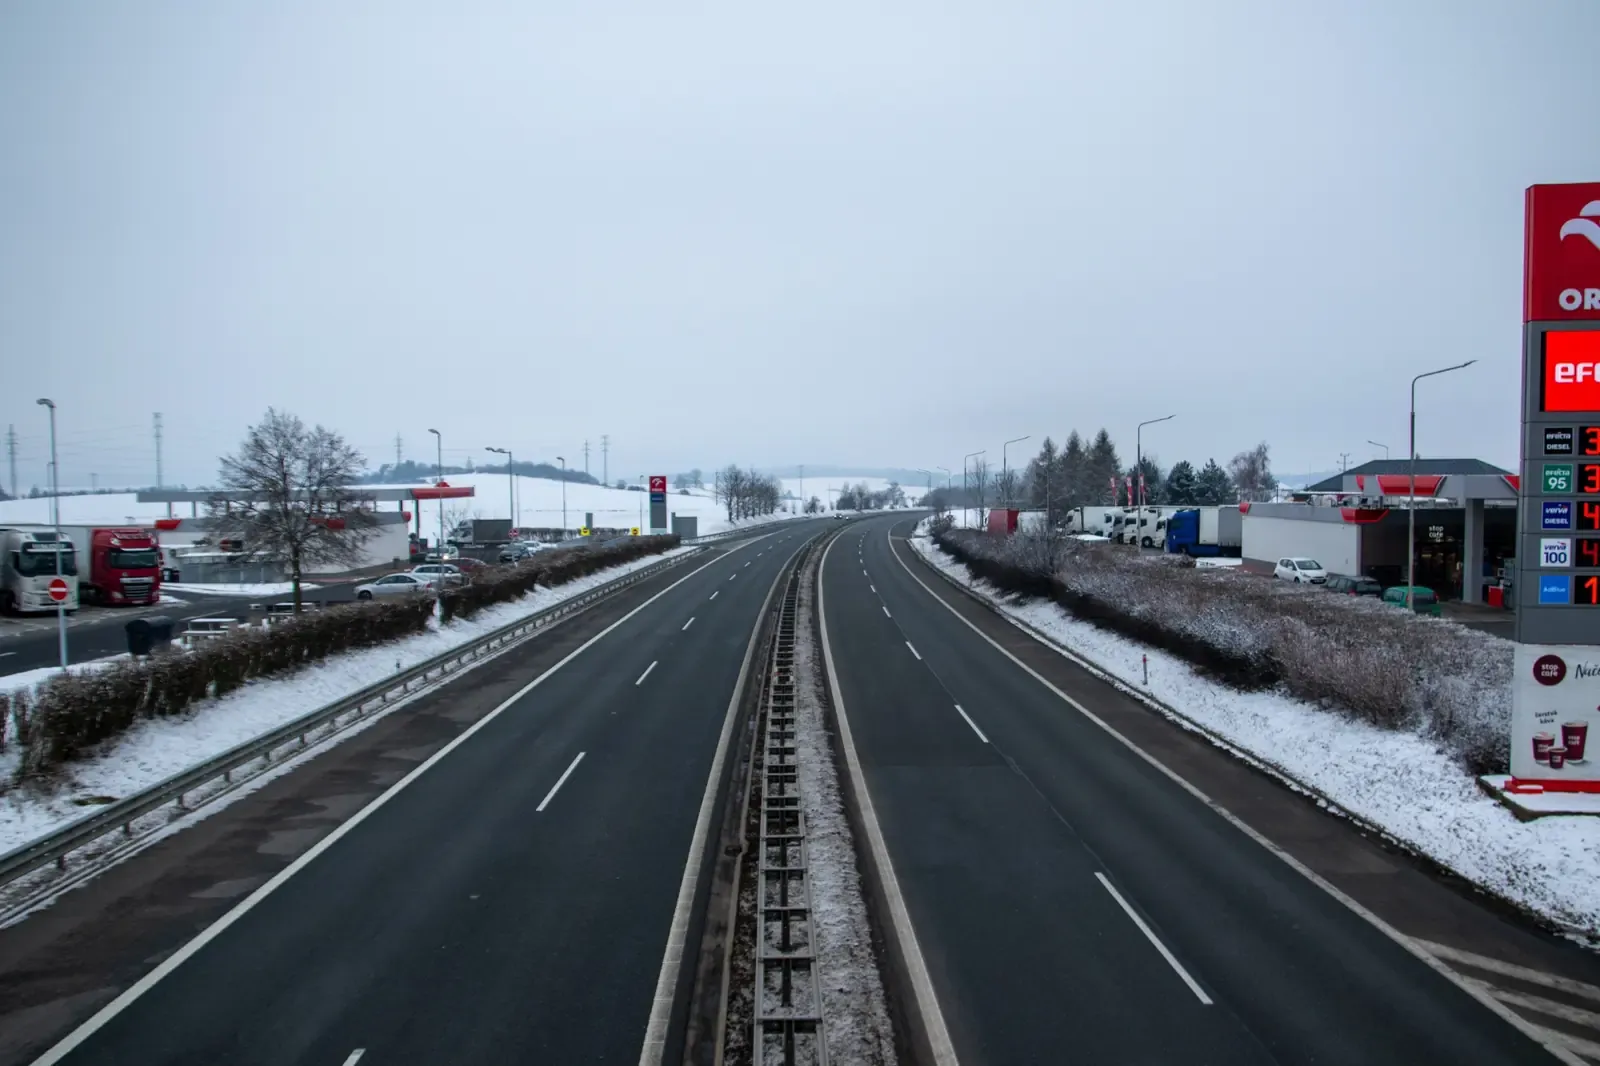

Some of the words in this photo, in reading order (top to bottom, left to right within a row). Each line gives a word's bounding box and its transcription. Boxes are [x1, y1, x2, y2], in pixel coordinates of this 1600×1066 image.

[1548, 477, 1567, 489] 95
[1544, 552, 1567, 563] 100
[1541, 664, 1559, 672] stop
